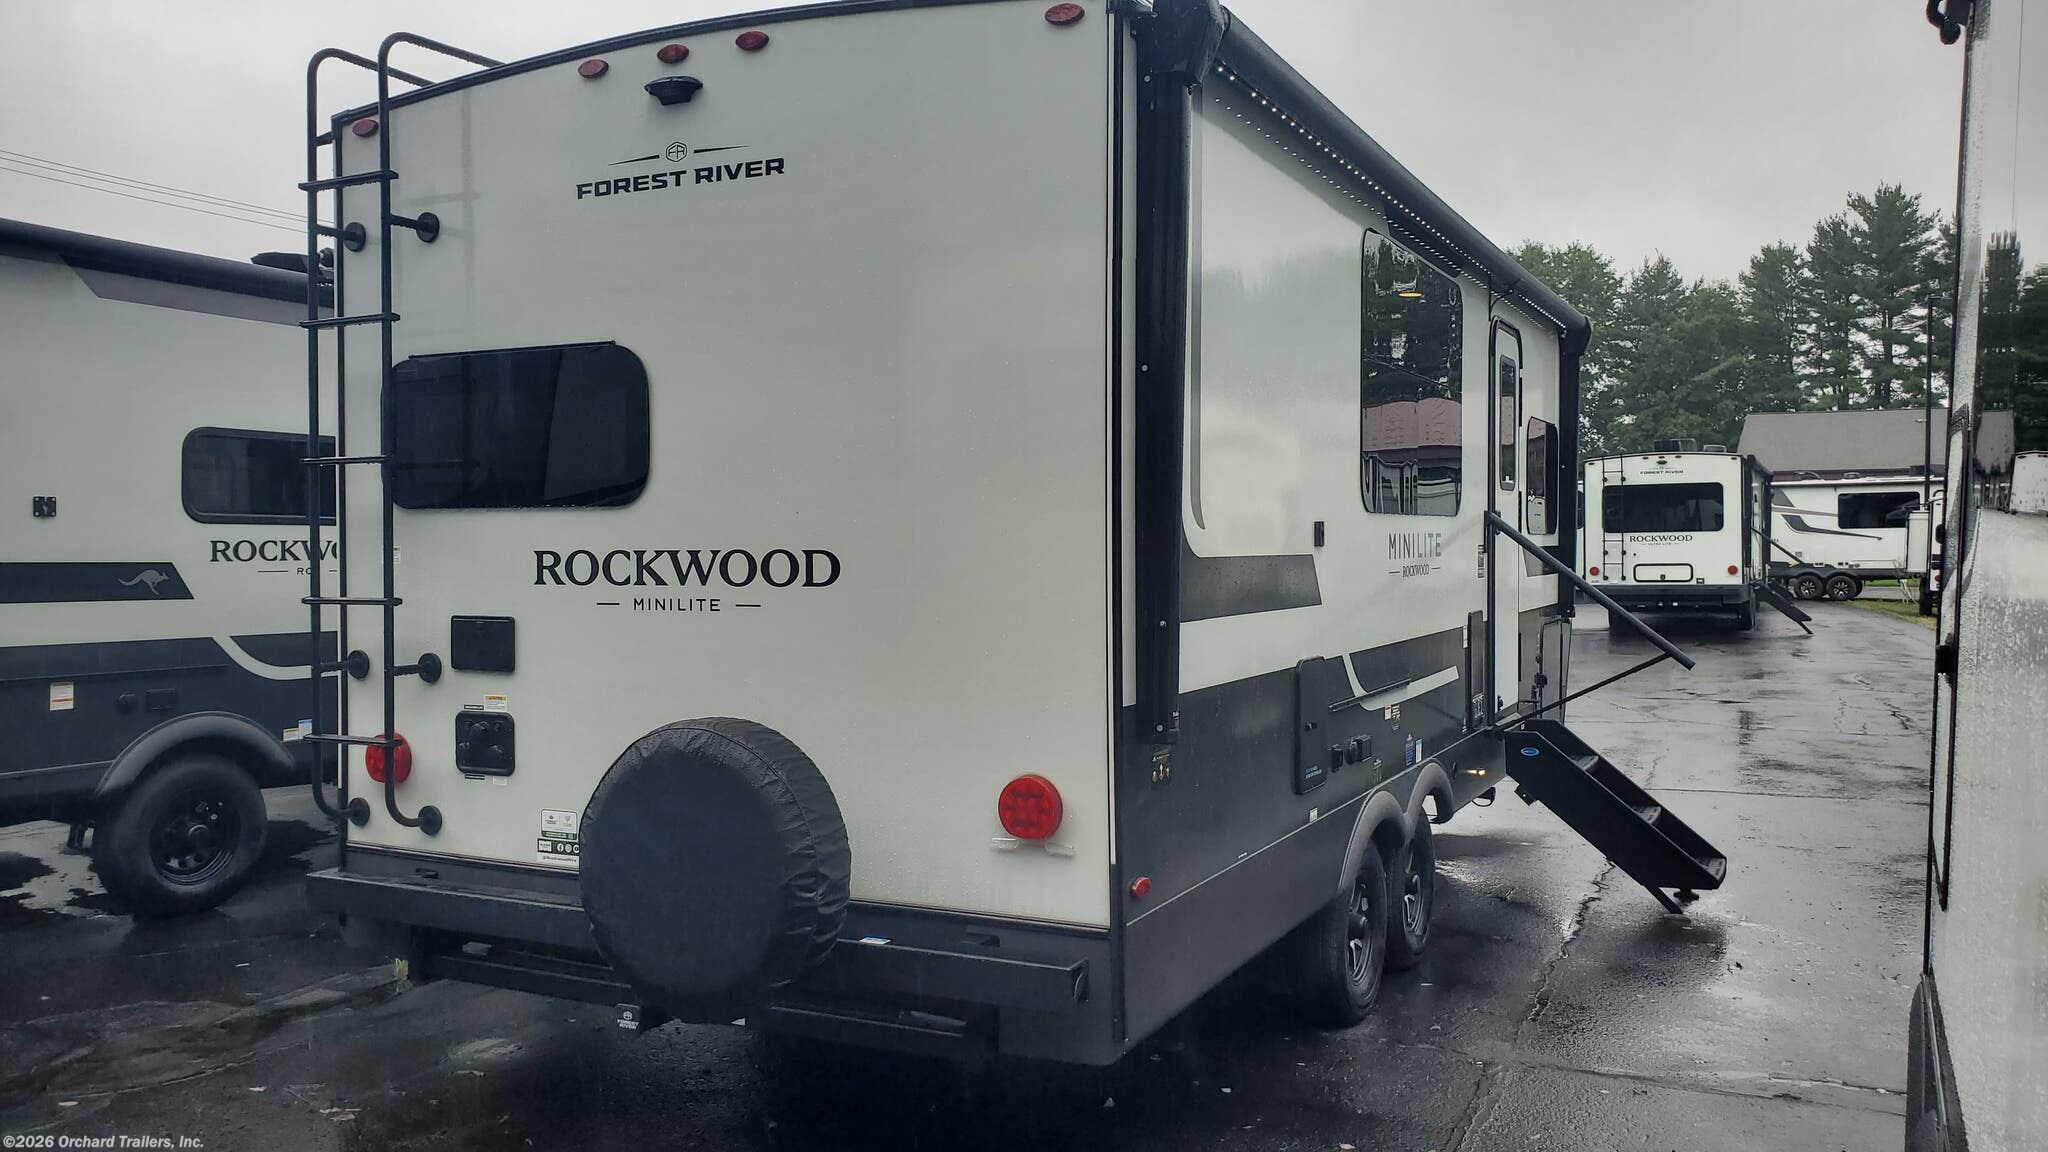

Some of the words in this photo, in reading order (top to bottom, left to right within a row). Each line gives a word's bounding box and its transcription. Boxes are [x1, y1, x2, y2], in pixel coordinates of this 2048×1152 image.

[576, 170, 687, 200] FOREST
[693, 157, 785, 185] RIVER
[1388, 532, 1441, 560] MINILITE
[1629, 534, 1693, 542] ROCKWOOD
[209, 540, 338, 562] ROCKW
[533, 549, 841, 588] ROCKWOOD
[1402, 564, 1430, 577] ROCKWOOD
[633, 598, 721, 612] MINILITE
